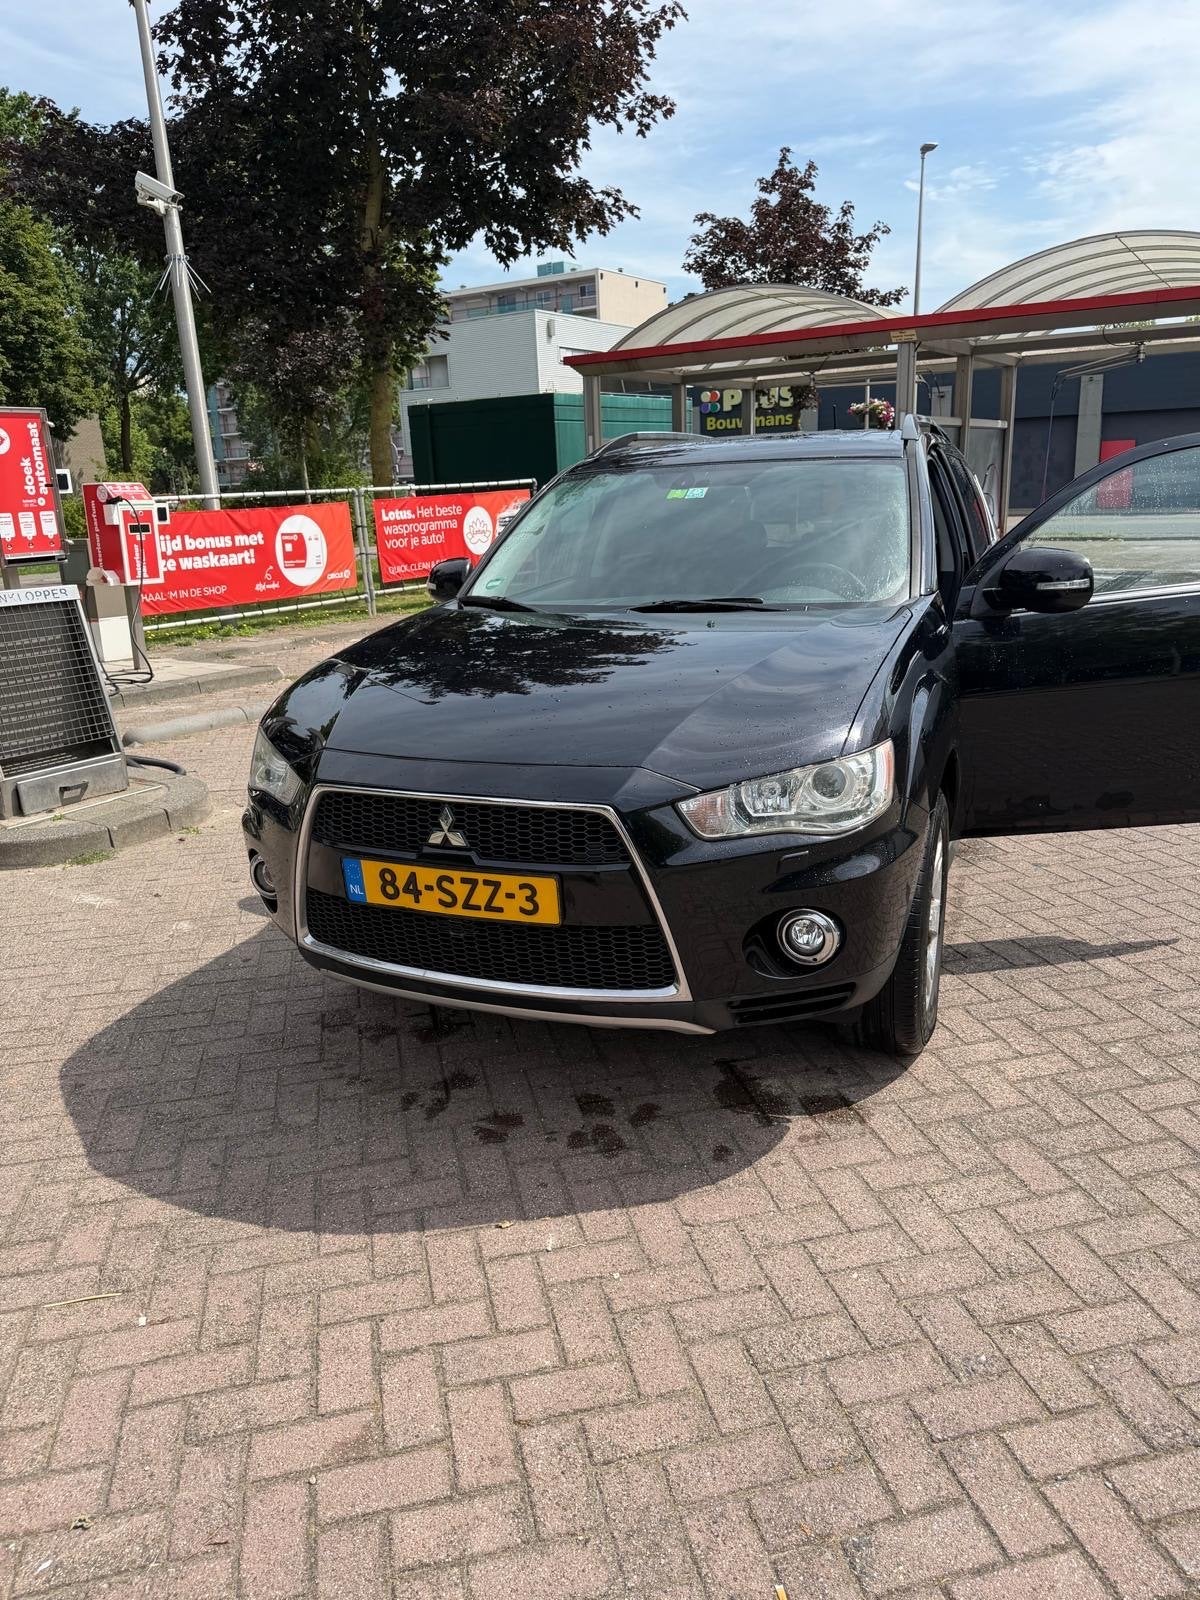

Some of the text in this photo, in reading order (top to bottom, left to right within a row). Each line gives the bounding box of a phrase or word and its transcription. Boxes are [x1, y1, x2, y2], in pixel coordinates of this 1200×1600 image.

[723, 386, 794, 411] Pus
[27, 423, 48, 495] automaat
[21, 457, 34, 495] doek
[381, 504, 462, 521] Lotus. Het beste
[384, 519, 458, 535] wasprogramma
[185, 533, 232, 550] bonus
[235, 532, 264, 545] met
[385, 532, 445, 549] voor je auto!
[179, 549, 255, 570] waskaart!
[141, 593, 166, 603] HAAL
[179, 589, 188, 598] IN
[190, 588, 201, 597] DE
[203, 586, 227, 596] SHOP
[350, 885, 364, 895] NL
[379, 867, 539, 915] 84-SZZ-3
